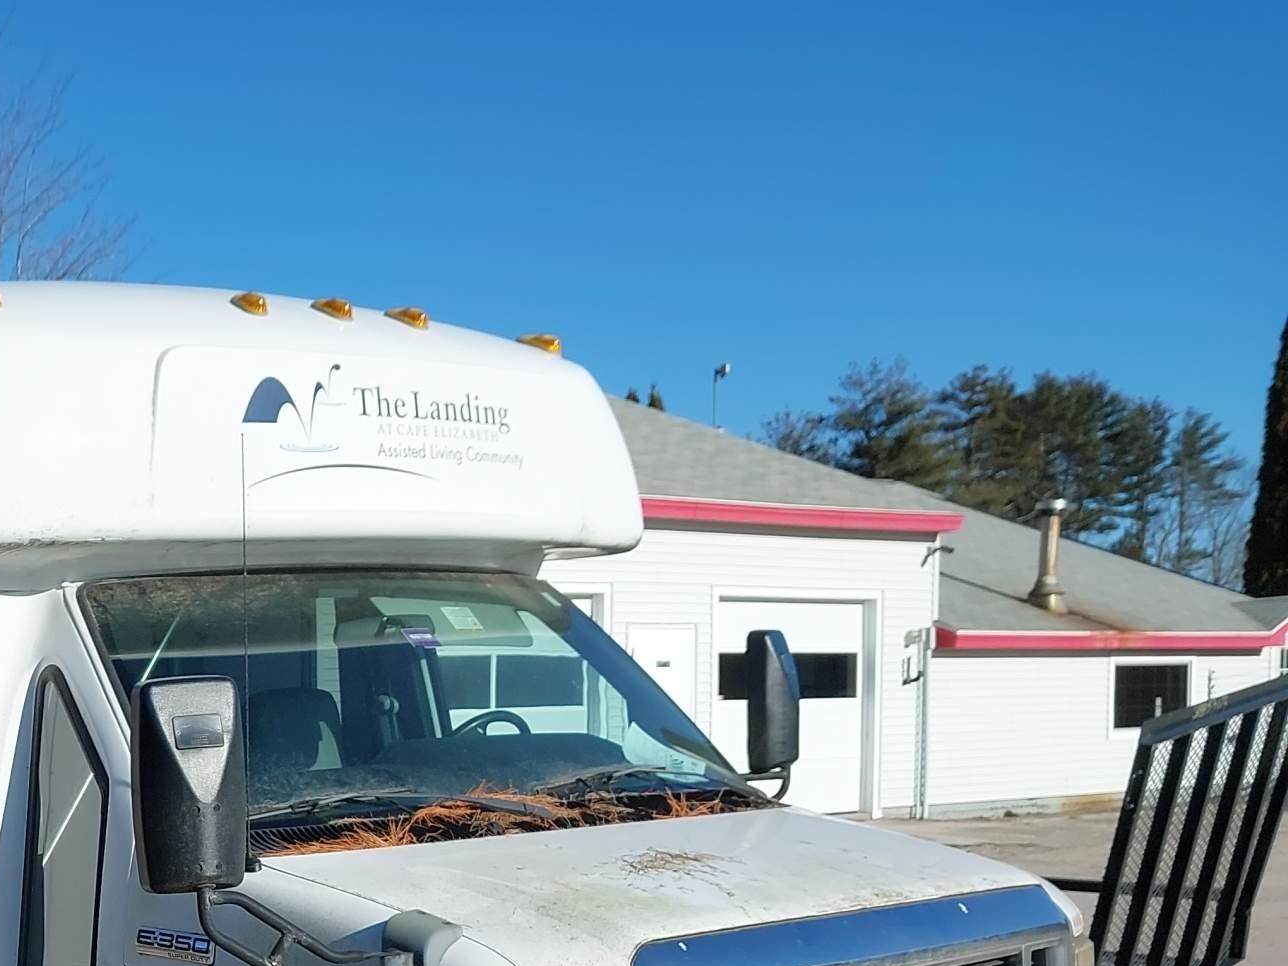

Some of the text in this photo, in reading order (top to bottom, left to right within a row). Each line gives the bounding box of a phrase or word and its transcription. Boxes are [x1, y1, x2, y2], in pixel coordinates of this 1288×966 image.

[352, 386, 511, 435] The Landing
[376, 422, 499, 442] AT CAPE ELIZABETH
[377, 442, 526, 471] Assisted Living Community
